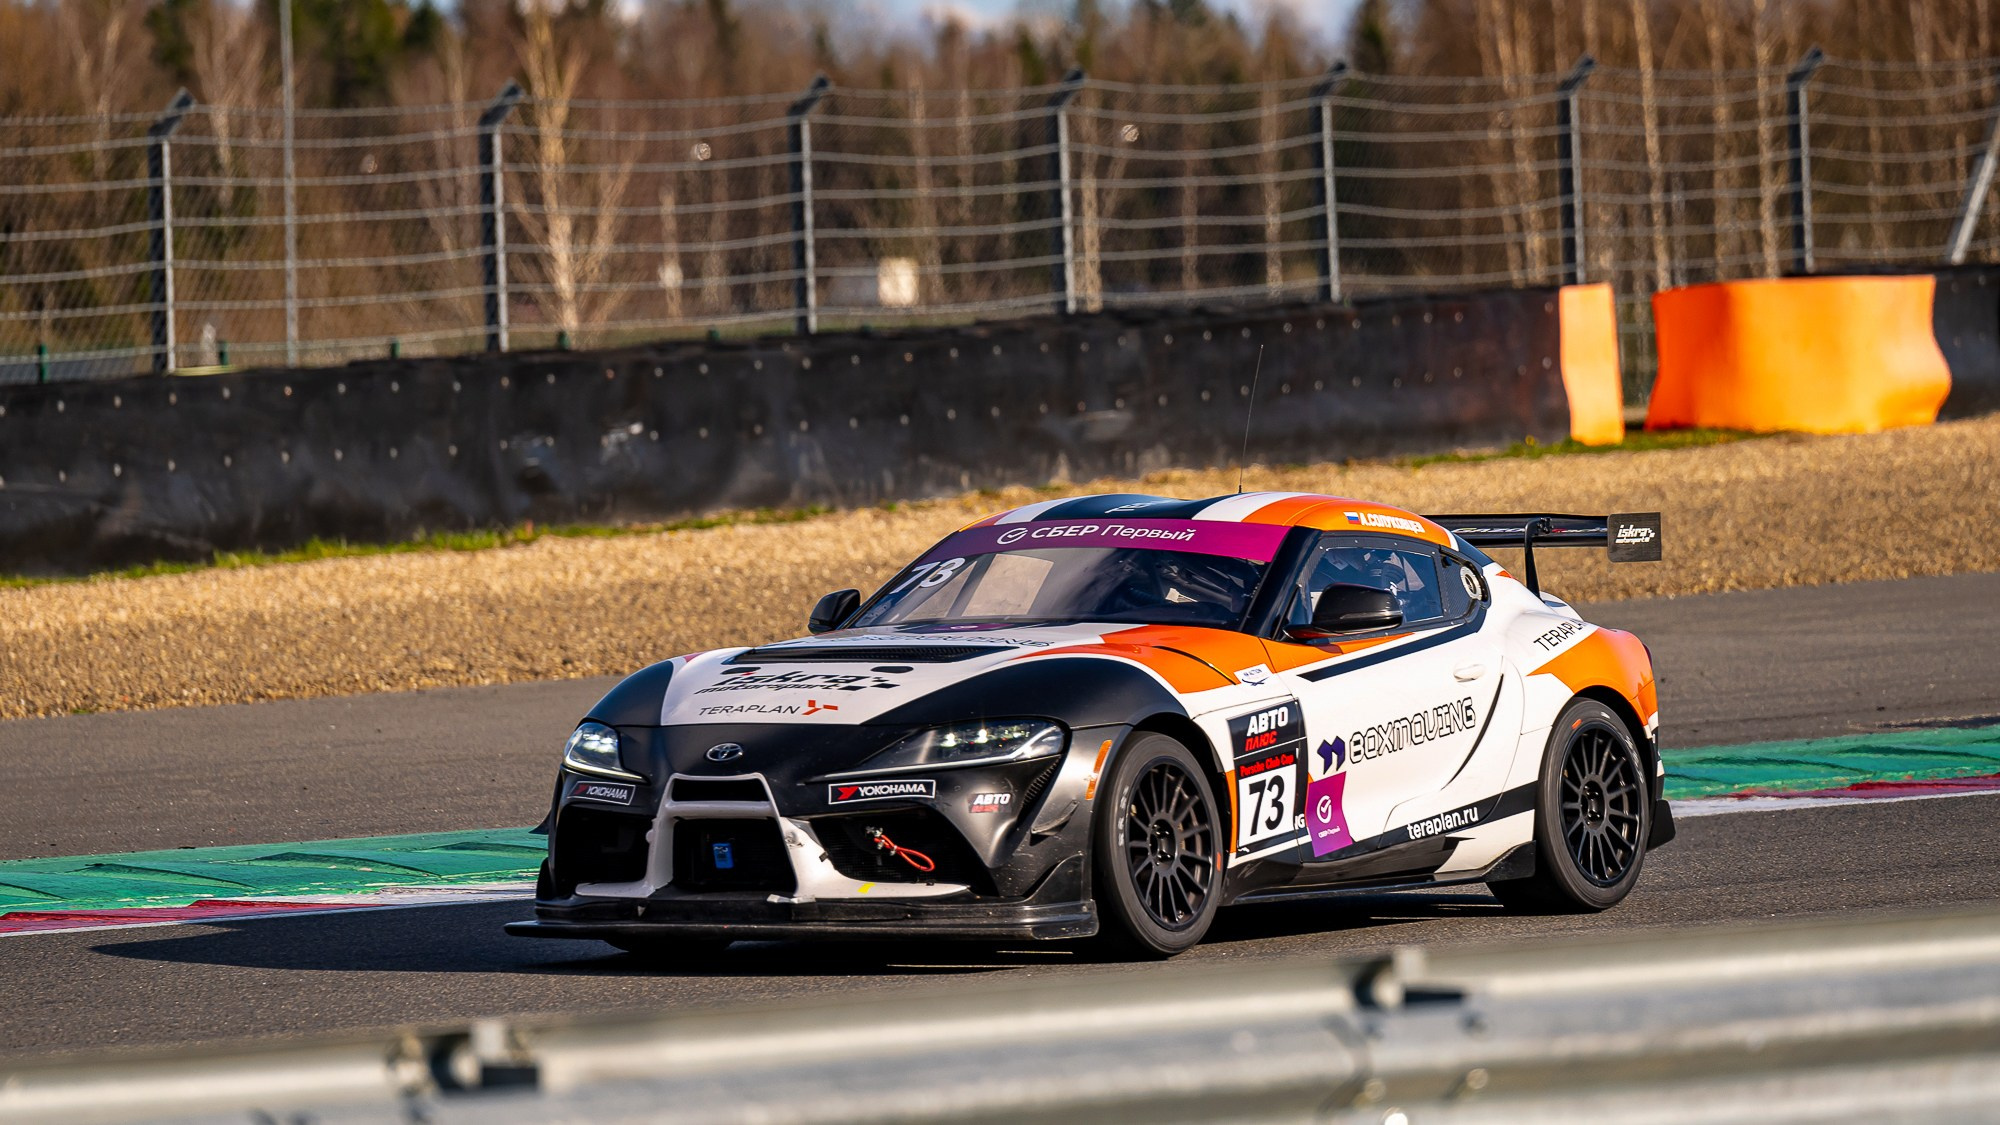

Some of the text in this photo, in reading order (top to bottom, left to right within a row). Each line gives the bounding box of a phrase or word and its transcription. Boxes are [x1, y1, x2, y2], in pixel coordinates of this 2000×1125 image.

[1030, 525, 1197, 542] СБЕР Первый
[1617, 524, 1649, 538] iskra
[889, 557, 966, 595] 73
[712, 670, 870, 687] iskra
[694, 683, 839, 695] motorsport
[698, 704, 801, 716] TERAPLAN
[1247, 706, 1289, 737] АВТО
[1244, 731, 1278, 752] ПЛЮС
[1239, 753, 1294, 777] Porsche Club Cup
[586, 785, 628, 800] YOKOHAMA
[858, 783, 927, 797] YOKOHAMA
[973, 793, 1011, 806] АВТО
[1248, 775, 1285, 837] 73
[1406, 807, 1479, 840] teraplan.ru
